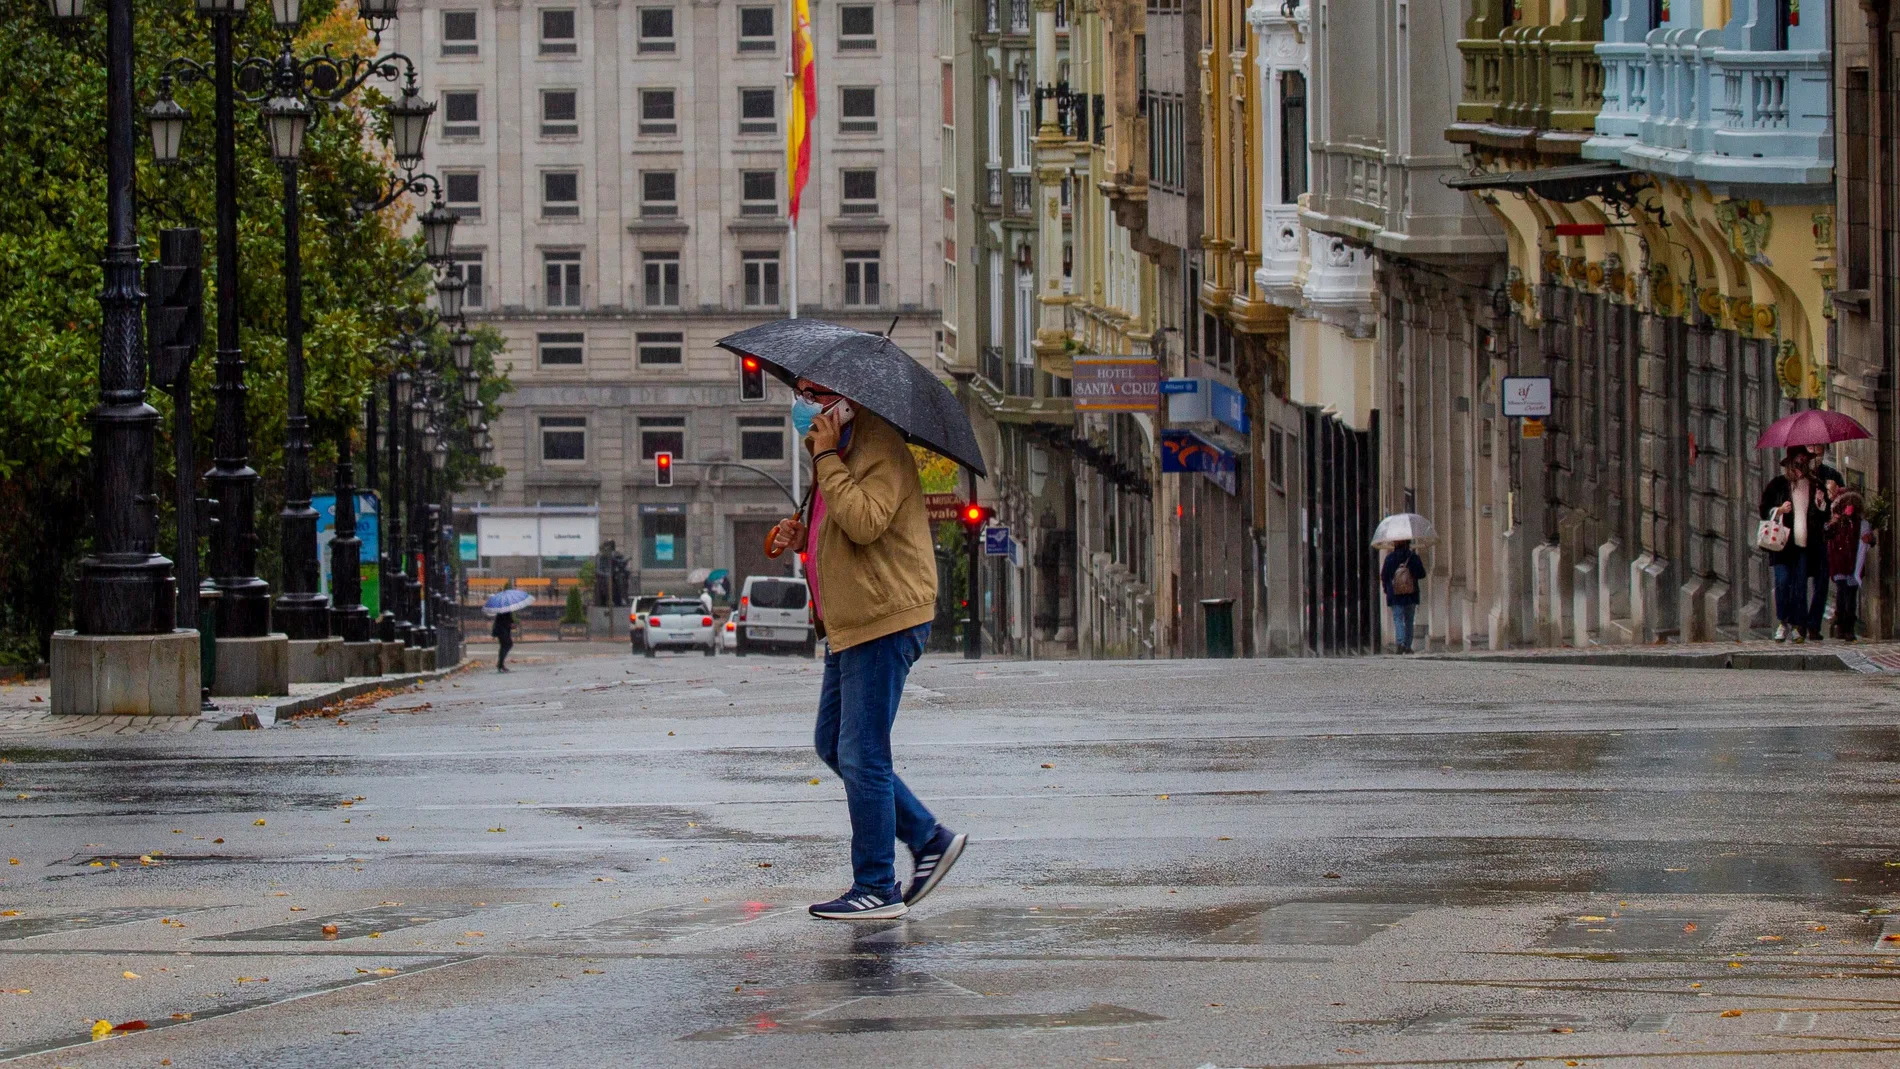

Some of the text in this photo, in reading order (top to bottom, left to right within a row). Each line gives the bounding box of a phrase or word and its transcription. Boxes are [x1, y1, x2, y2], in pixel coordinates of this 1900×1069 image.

[1097, 368, 1136, 379] HOTEL
[1074, 382, 1158, 395] SANTA CRUZ
